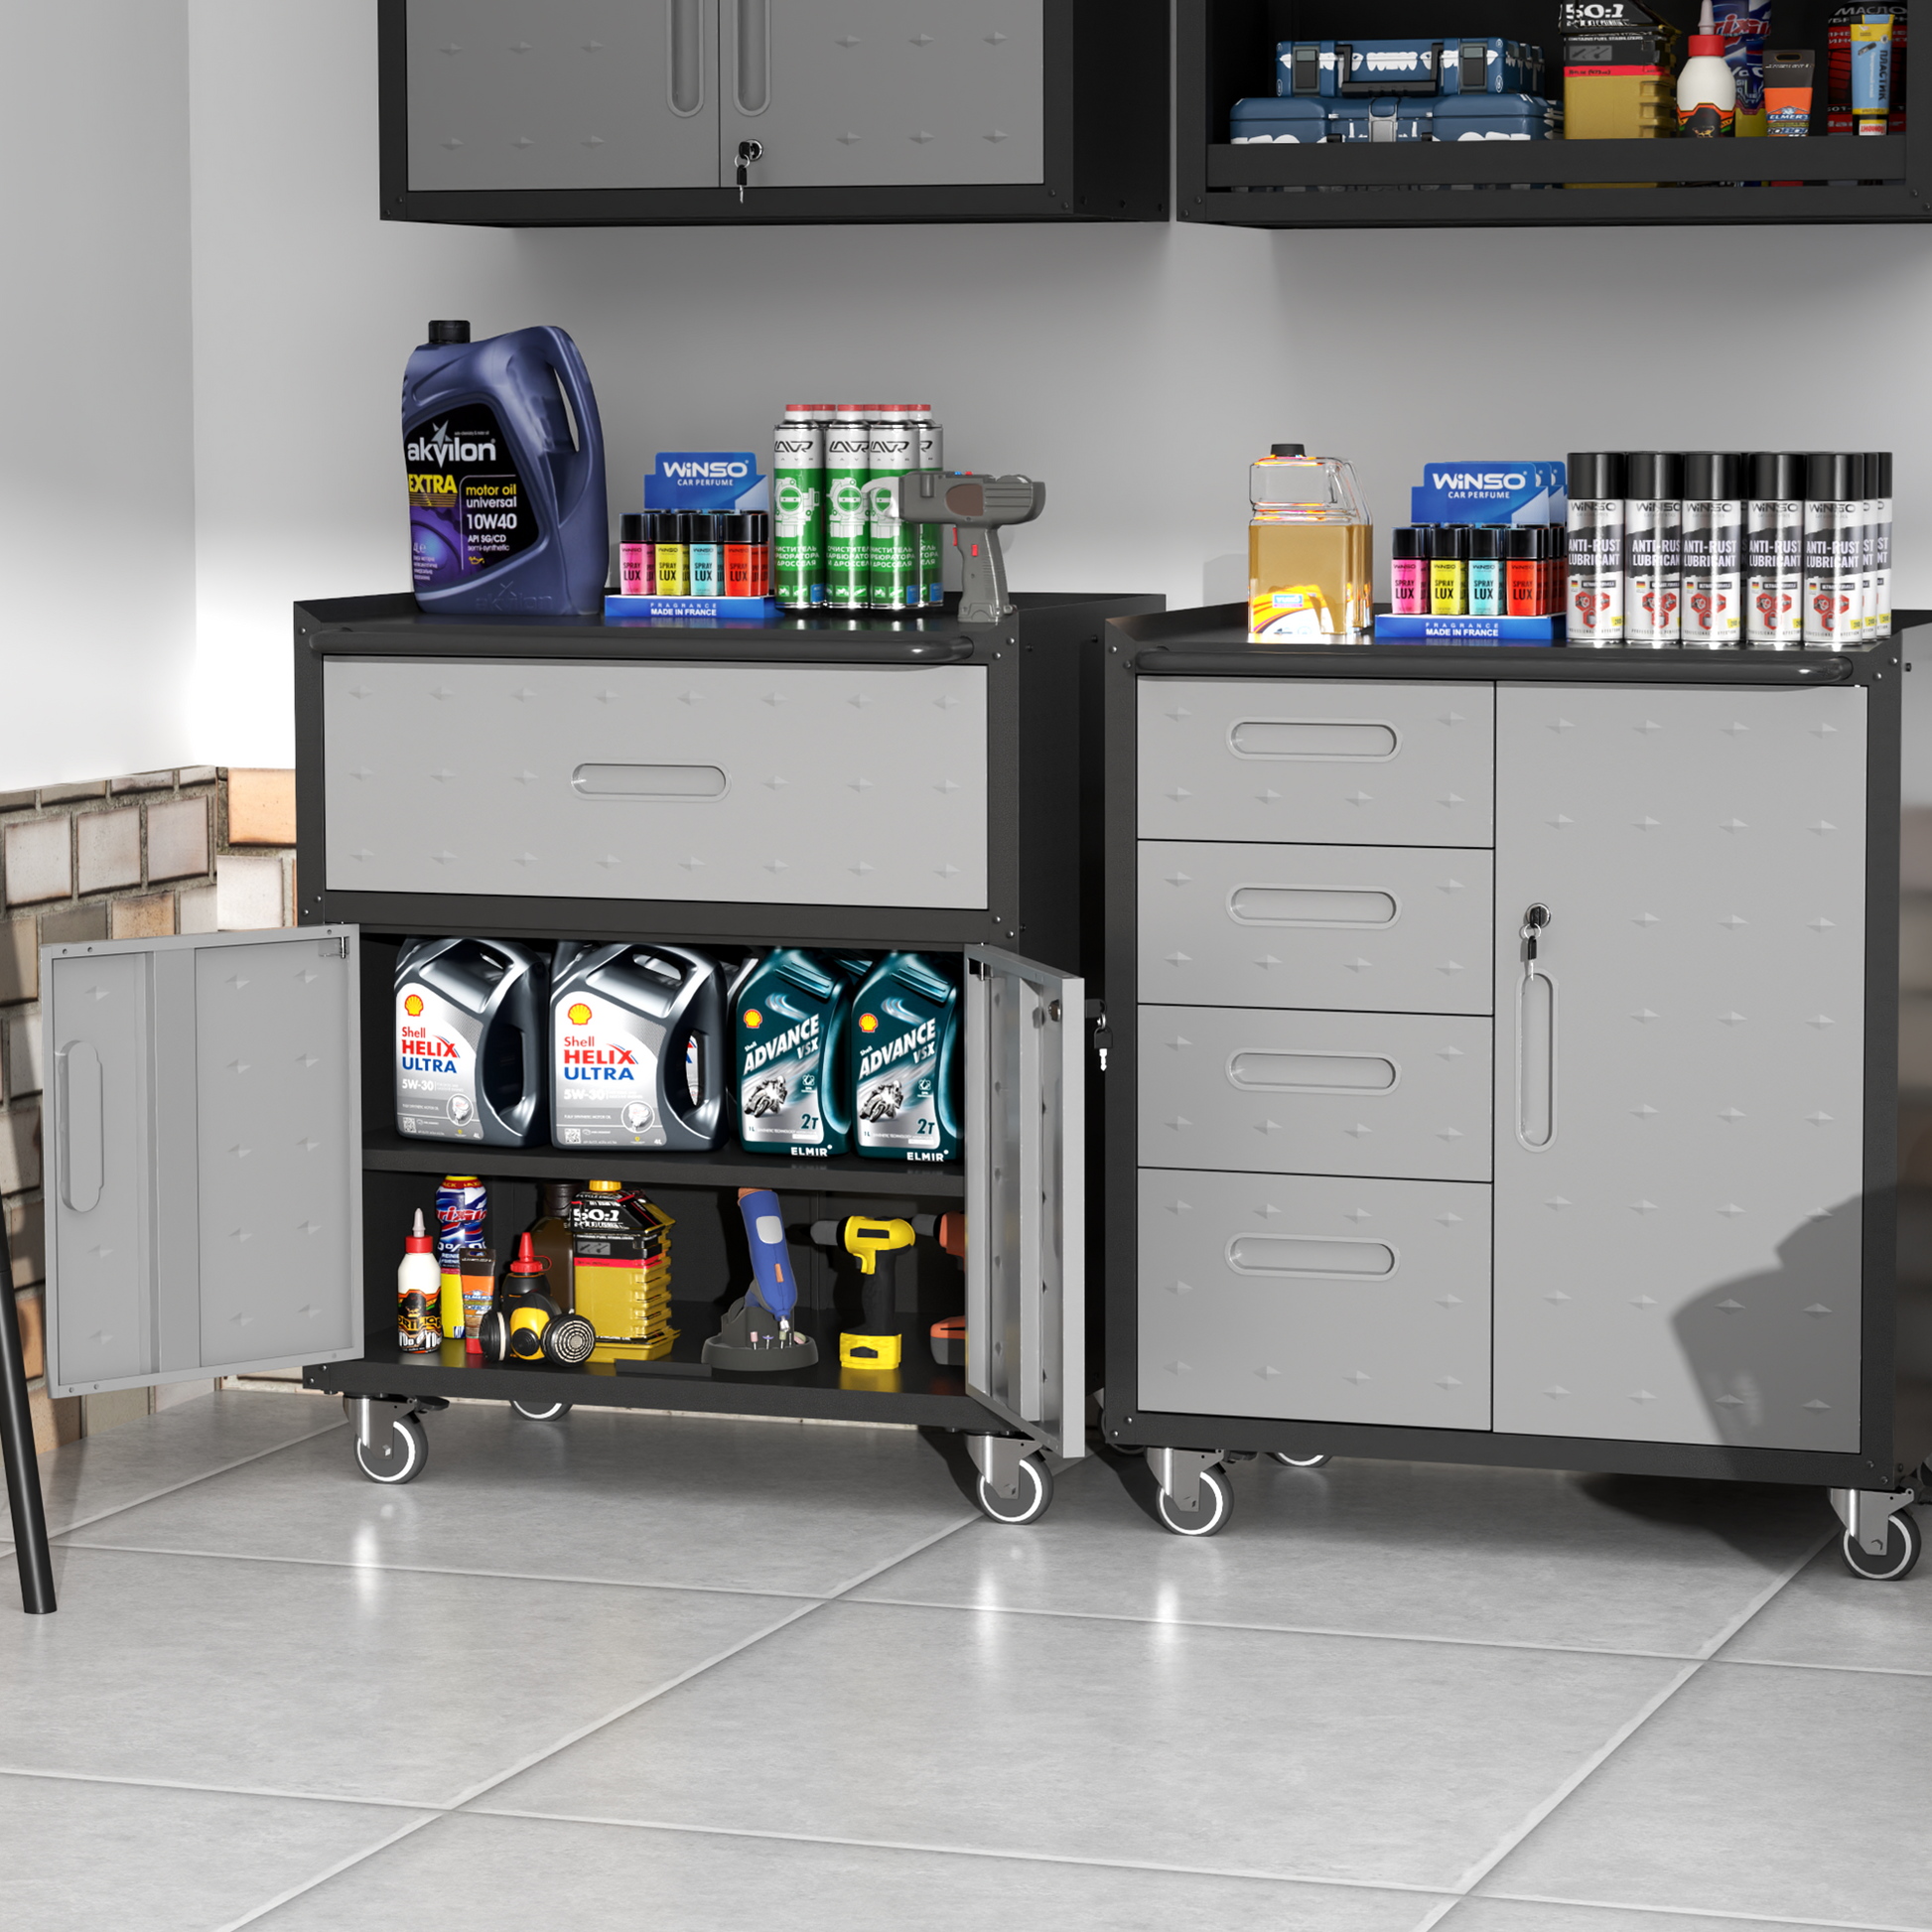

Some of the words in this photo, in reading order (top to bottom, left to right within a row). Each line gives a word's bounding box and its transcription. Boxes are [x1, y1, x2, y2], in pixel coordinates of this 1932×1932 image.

[1835, 6, 1907, 16] МАСЛО
[1878, 50, 1889, 101] ПЛАСТИК
[407, 437, 496, 469] akvilon
[408, 474, 458, 493] EXTRA
[466, 483, 499, 495] motor
[501, 483, 517, 495] oil
[466, 496, 517, 508] universal
[467, 513, 517, 530] 10W40
[468, 534, 480, 543] API
[1569, 539, 1621, 552] ANTI-RUST
[1632, 539, 1680, 552] ANTI-RUS
[1684, 539, 1736, 553] ANTI-RUST
[1749, 539, 1802, 553] ANTI-RUST
[1806, 540, 1860, 554] ANTI-RUST
[1569, 553, 1620, 566] LUBRICANT
[1632, 554, 1680, 566] LUBRICAN
[1684, 555, 1736, 567] LUBRICANT
[1749, 555, 1802, 567] LUBRICANT
[1807, 556, 1860, 568] LUBRICANT
[623, 570, 641, 581] LUX
[659, 570, 677, 582] LUX
[695, 570, 713, 582] LUX
[730, 571, 748, 582] LUX
[1395, 588, 1415, 600] LUX
[1435, 588, 1454, 600] LUX
[1474, 588, 1494, 600] LUX
[1513, 588, 1533, 601] LUX
[402, 1026, 426, 1038] Shell
[401, 1036, 460, 1058] HELIX
[564, 1035, 595, 1047] Shell
[743, 1013, 819, 1076] ADVANCE
[796, 1036, 819, 1059] VSX
[563, 1045, 638, 1064] HELIX
[858, 1018, 935, 1080] ADVANCE
[912, 1041, 935, 1064] VSX
[402, 1056, 458, 1073] ULTRA
[564, 1066, 634, 1081] ULTRA
[401, 1078, 434, 1091] 5W-30
[563, 1088, 606, 1100] 5W-30
[800, 1114, 819, 1130] 2T
[916, 1118, 935, 1135] 2T
[790, 1147, 828, 1157] ELMIR
[906, 1152, 944, 1162] ELMIR
